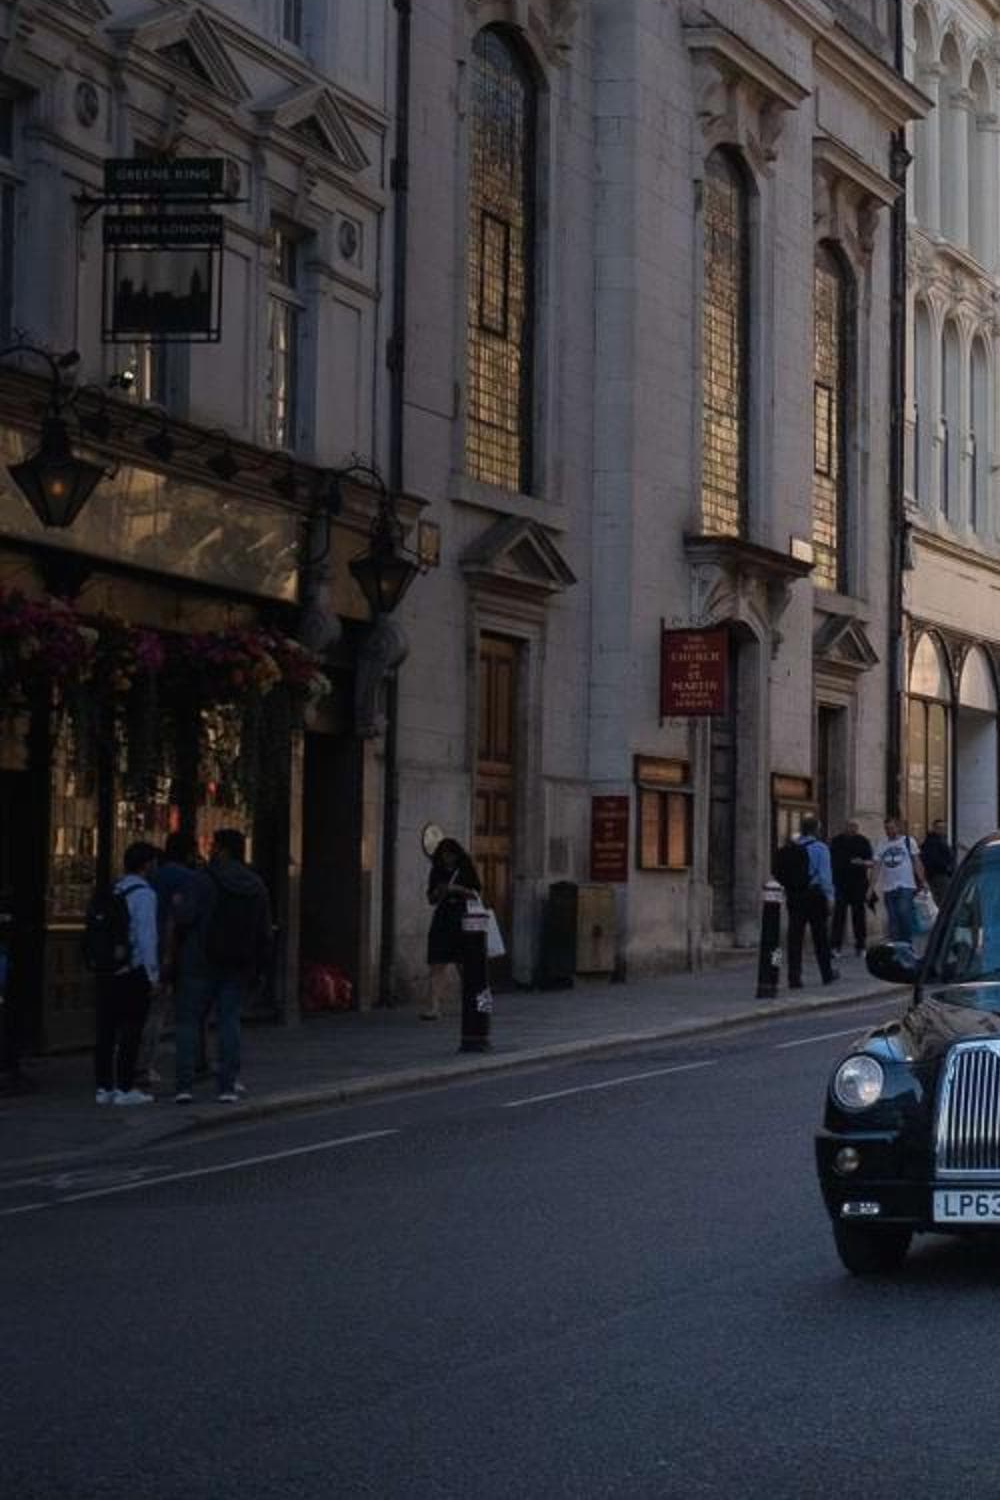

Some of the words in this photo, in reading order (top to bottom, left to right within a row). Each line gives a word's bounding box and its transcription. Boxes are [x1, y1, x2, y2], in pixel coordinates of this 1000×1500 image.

[115, 167, 169, 181] GREENE
[175, 167, 211, 181] KING
[671, 651, 720, 661] CHURCH
[671, 681, 719, 691] MARTIN
